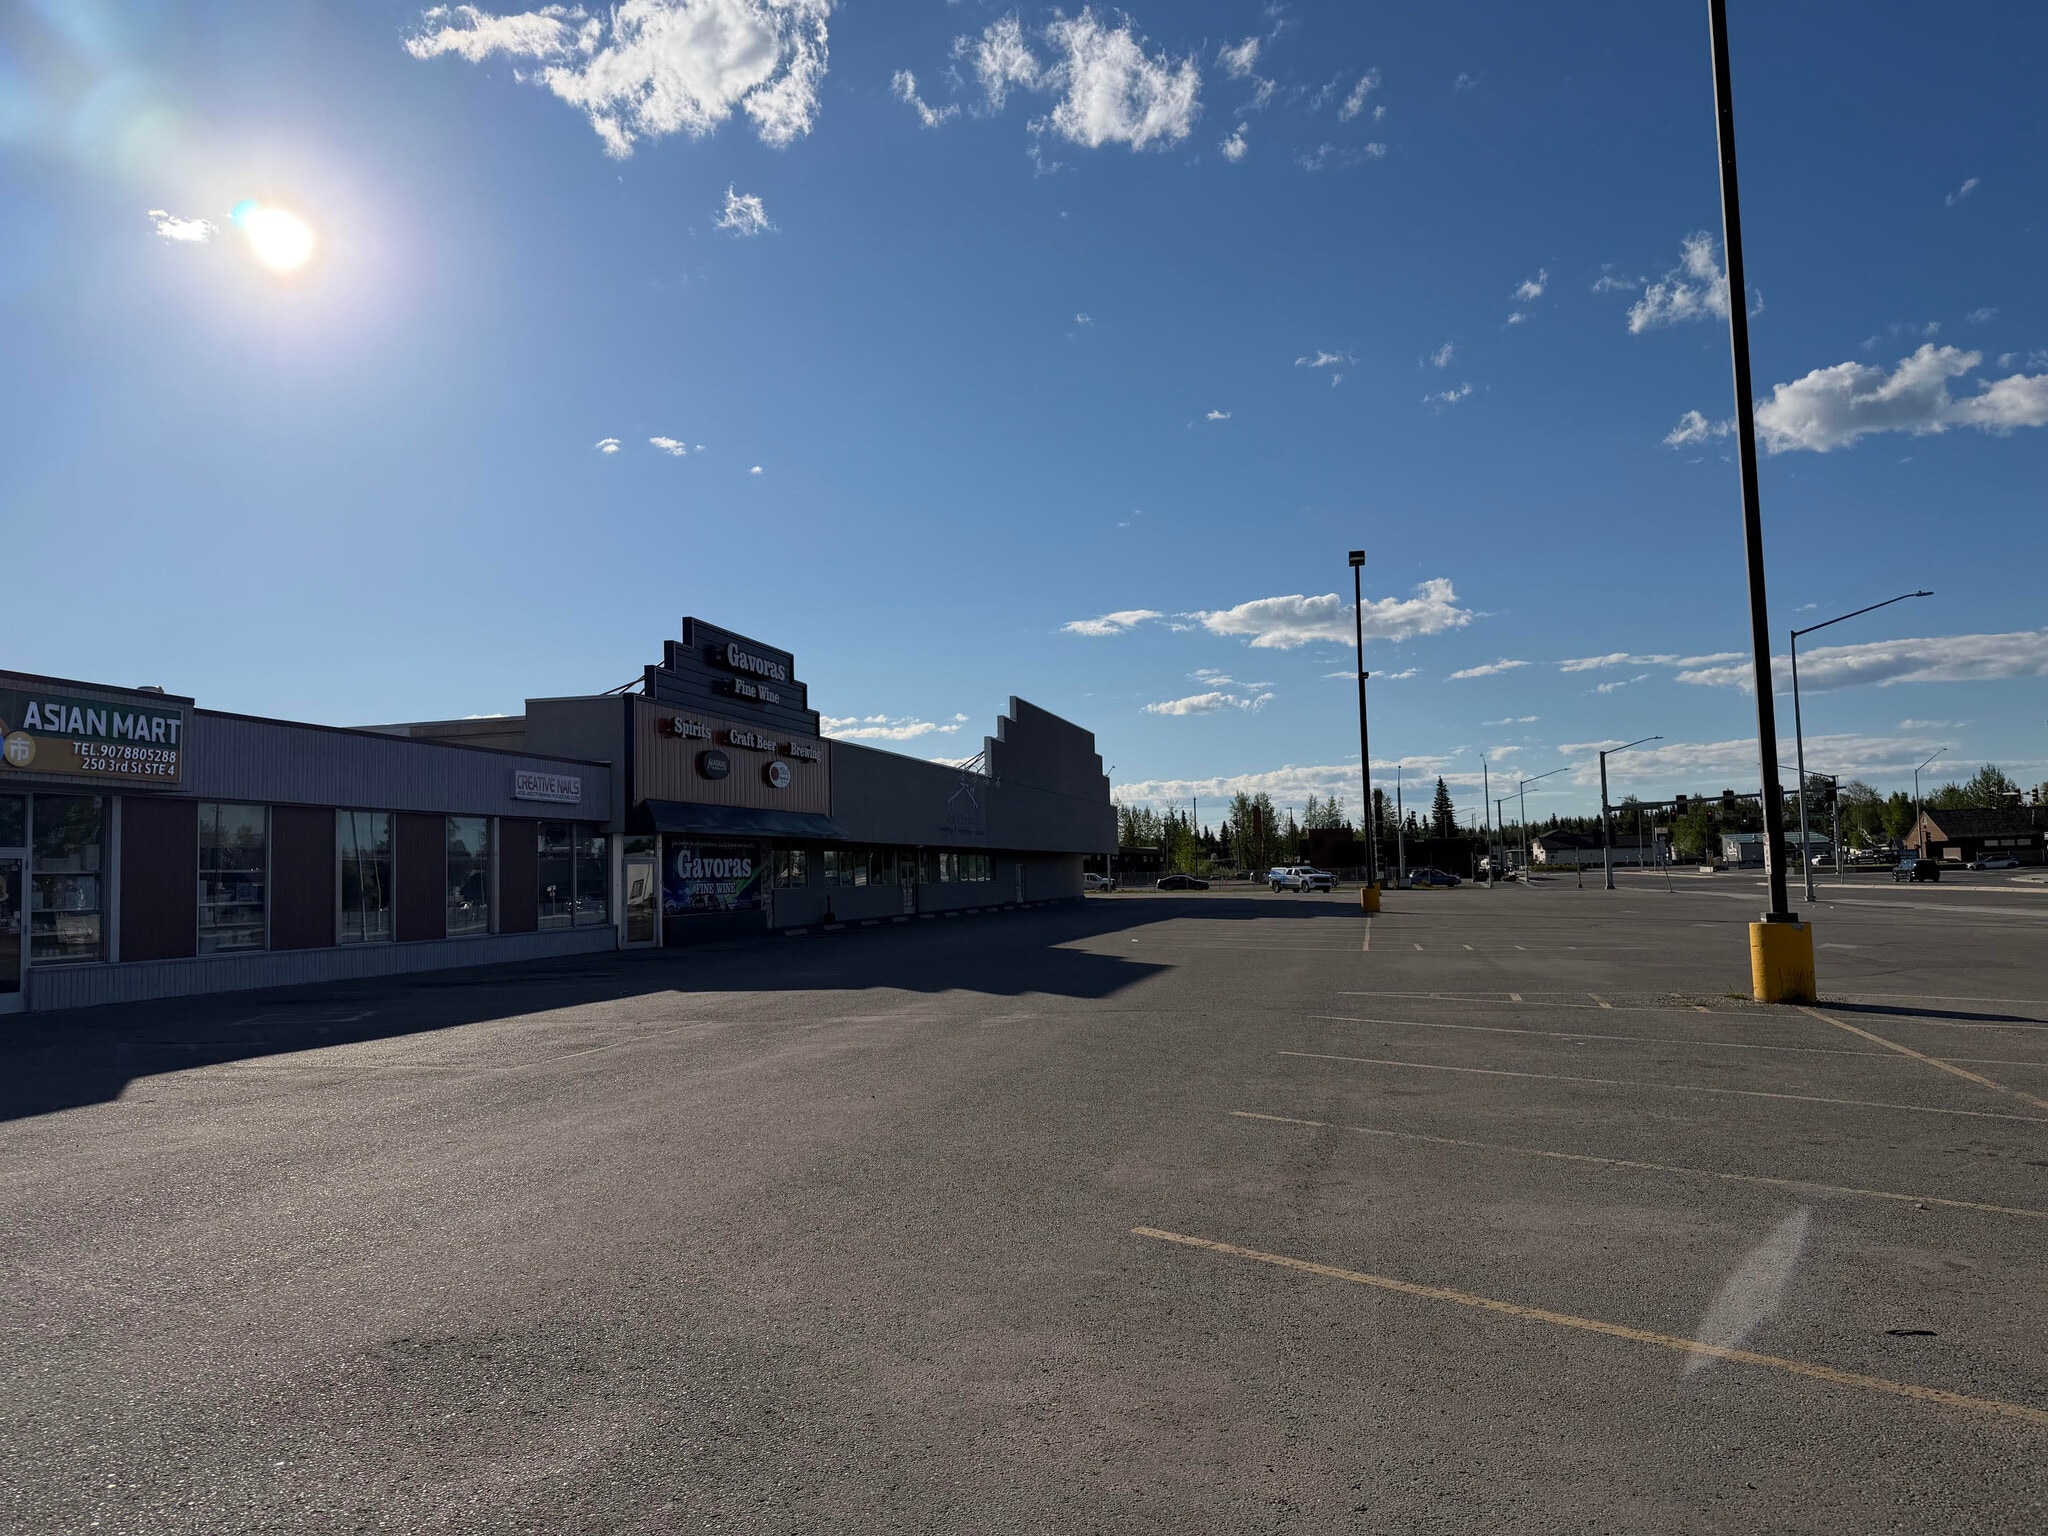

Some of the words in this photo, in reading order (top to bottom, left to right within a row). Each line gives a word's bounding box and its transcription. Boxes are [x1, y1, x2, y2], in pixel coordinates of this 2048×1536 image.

[727, 642, 785, 681] Gavoras
[734, 677, 757, 698] Fine
[758, 685, 780, 704] Wine
[23, 701, 107, 737] ASIAN
[112, 711, 181, 744] MART
[674, 717, 712, 739] Spirits
[729, 729, 754, 748] Craft
[756, 735, 776, 751] Beer
[73, 742, 177, 763] TEL.9078805288
[790, 742, 821, 764] Brewing
[82, 758, 105, 771] 250
[108, 760, 128, 773] 3rd
[131, 762, 142, 774] St
[145, 763, 165, 775] STE
[168, 765, 175, 776] 4
[517, 775, 555, 793] CREATIVE
[557, 779, 579, 795] NAILS
[678, 849, 751, 879] Gavoras
[695, 882, 714, 895] FINE
[716, 882, 736, 894] WINE
